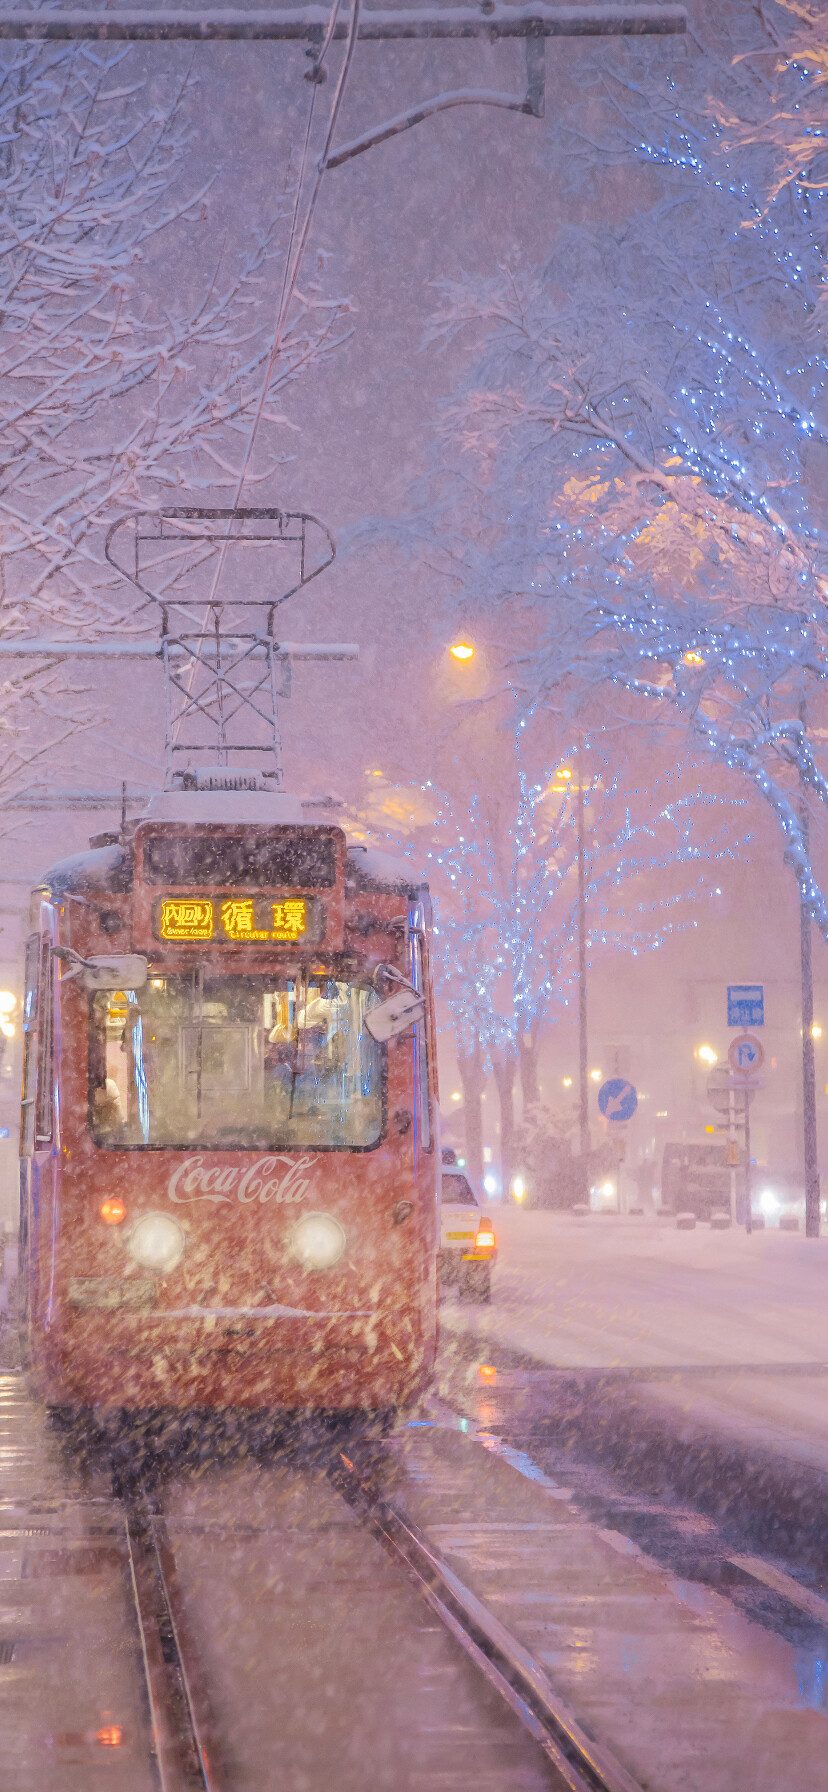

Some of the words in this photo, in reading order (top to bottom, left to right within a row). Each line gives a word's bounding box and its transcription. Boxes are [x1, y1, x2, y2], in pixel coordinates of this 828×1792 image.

[165, 904, 211, 926] 内回り
[221, 901, 305, 930] 循環
[190, 927, 208, 936] loop
[229, 930, 268, 939] Circular
[272, 931, 297, 939] route
